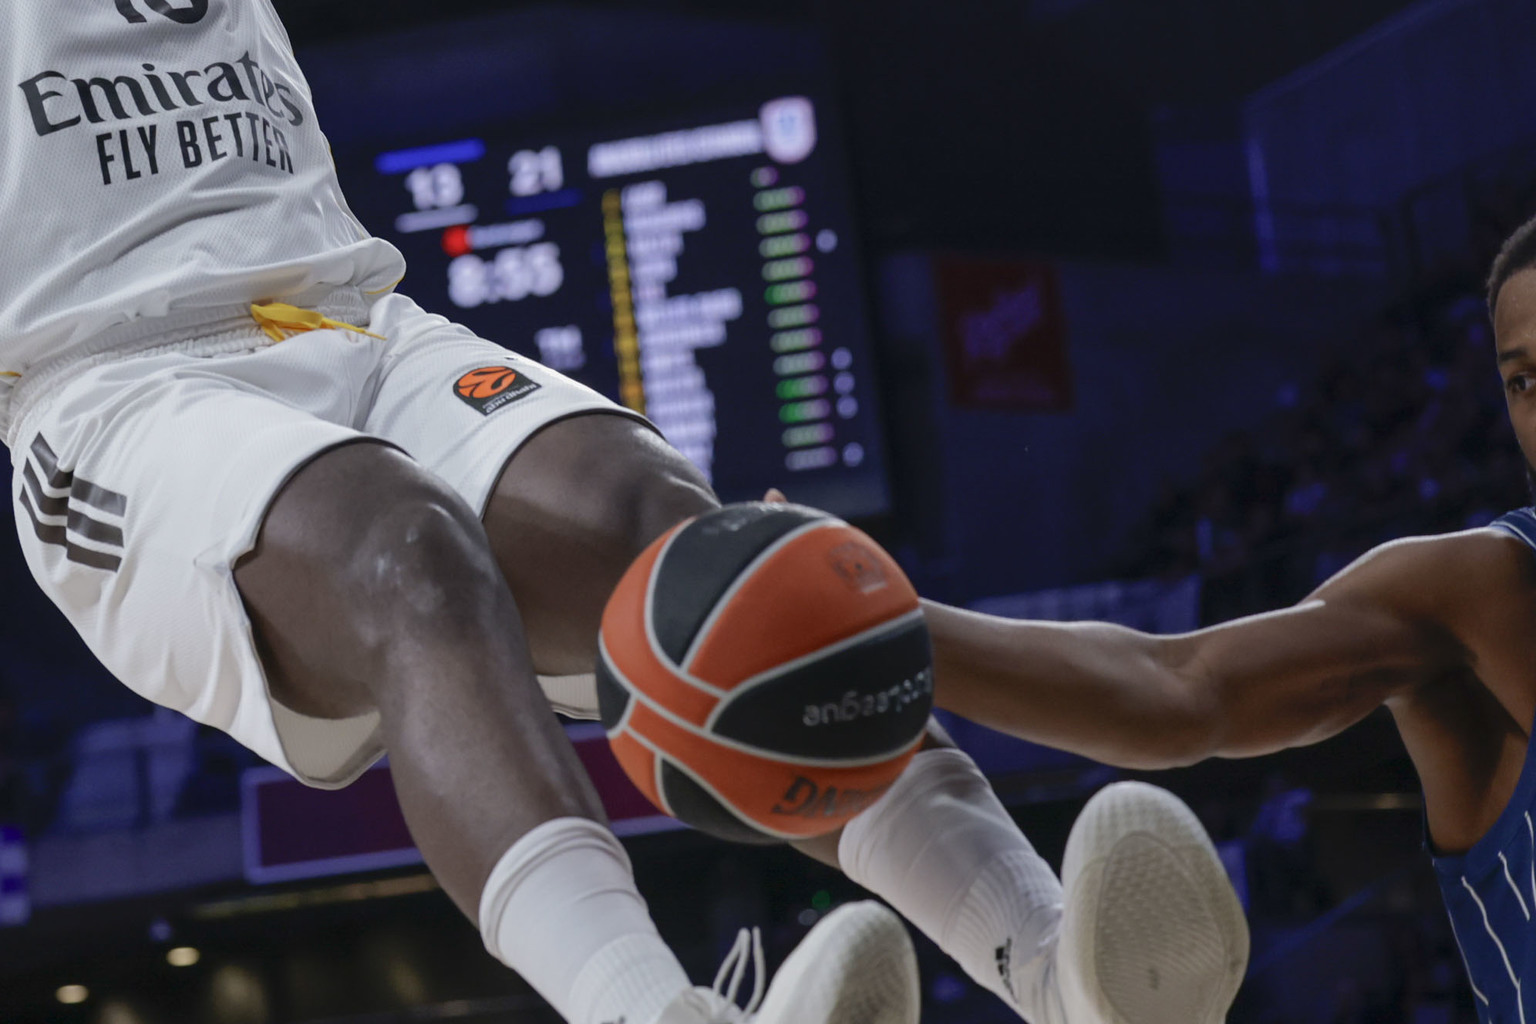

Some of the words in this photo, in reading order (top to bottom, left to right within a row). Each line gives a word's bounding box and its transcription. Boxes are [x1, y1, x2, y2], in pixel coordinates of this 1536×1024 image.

[18, 50, 304, 137] Emirates
[96, 124, 159, 186] FLY
[176, 111, 294, 175] BETTER
